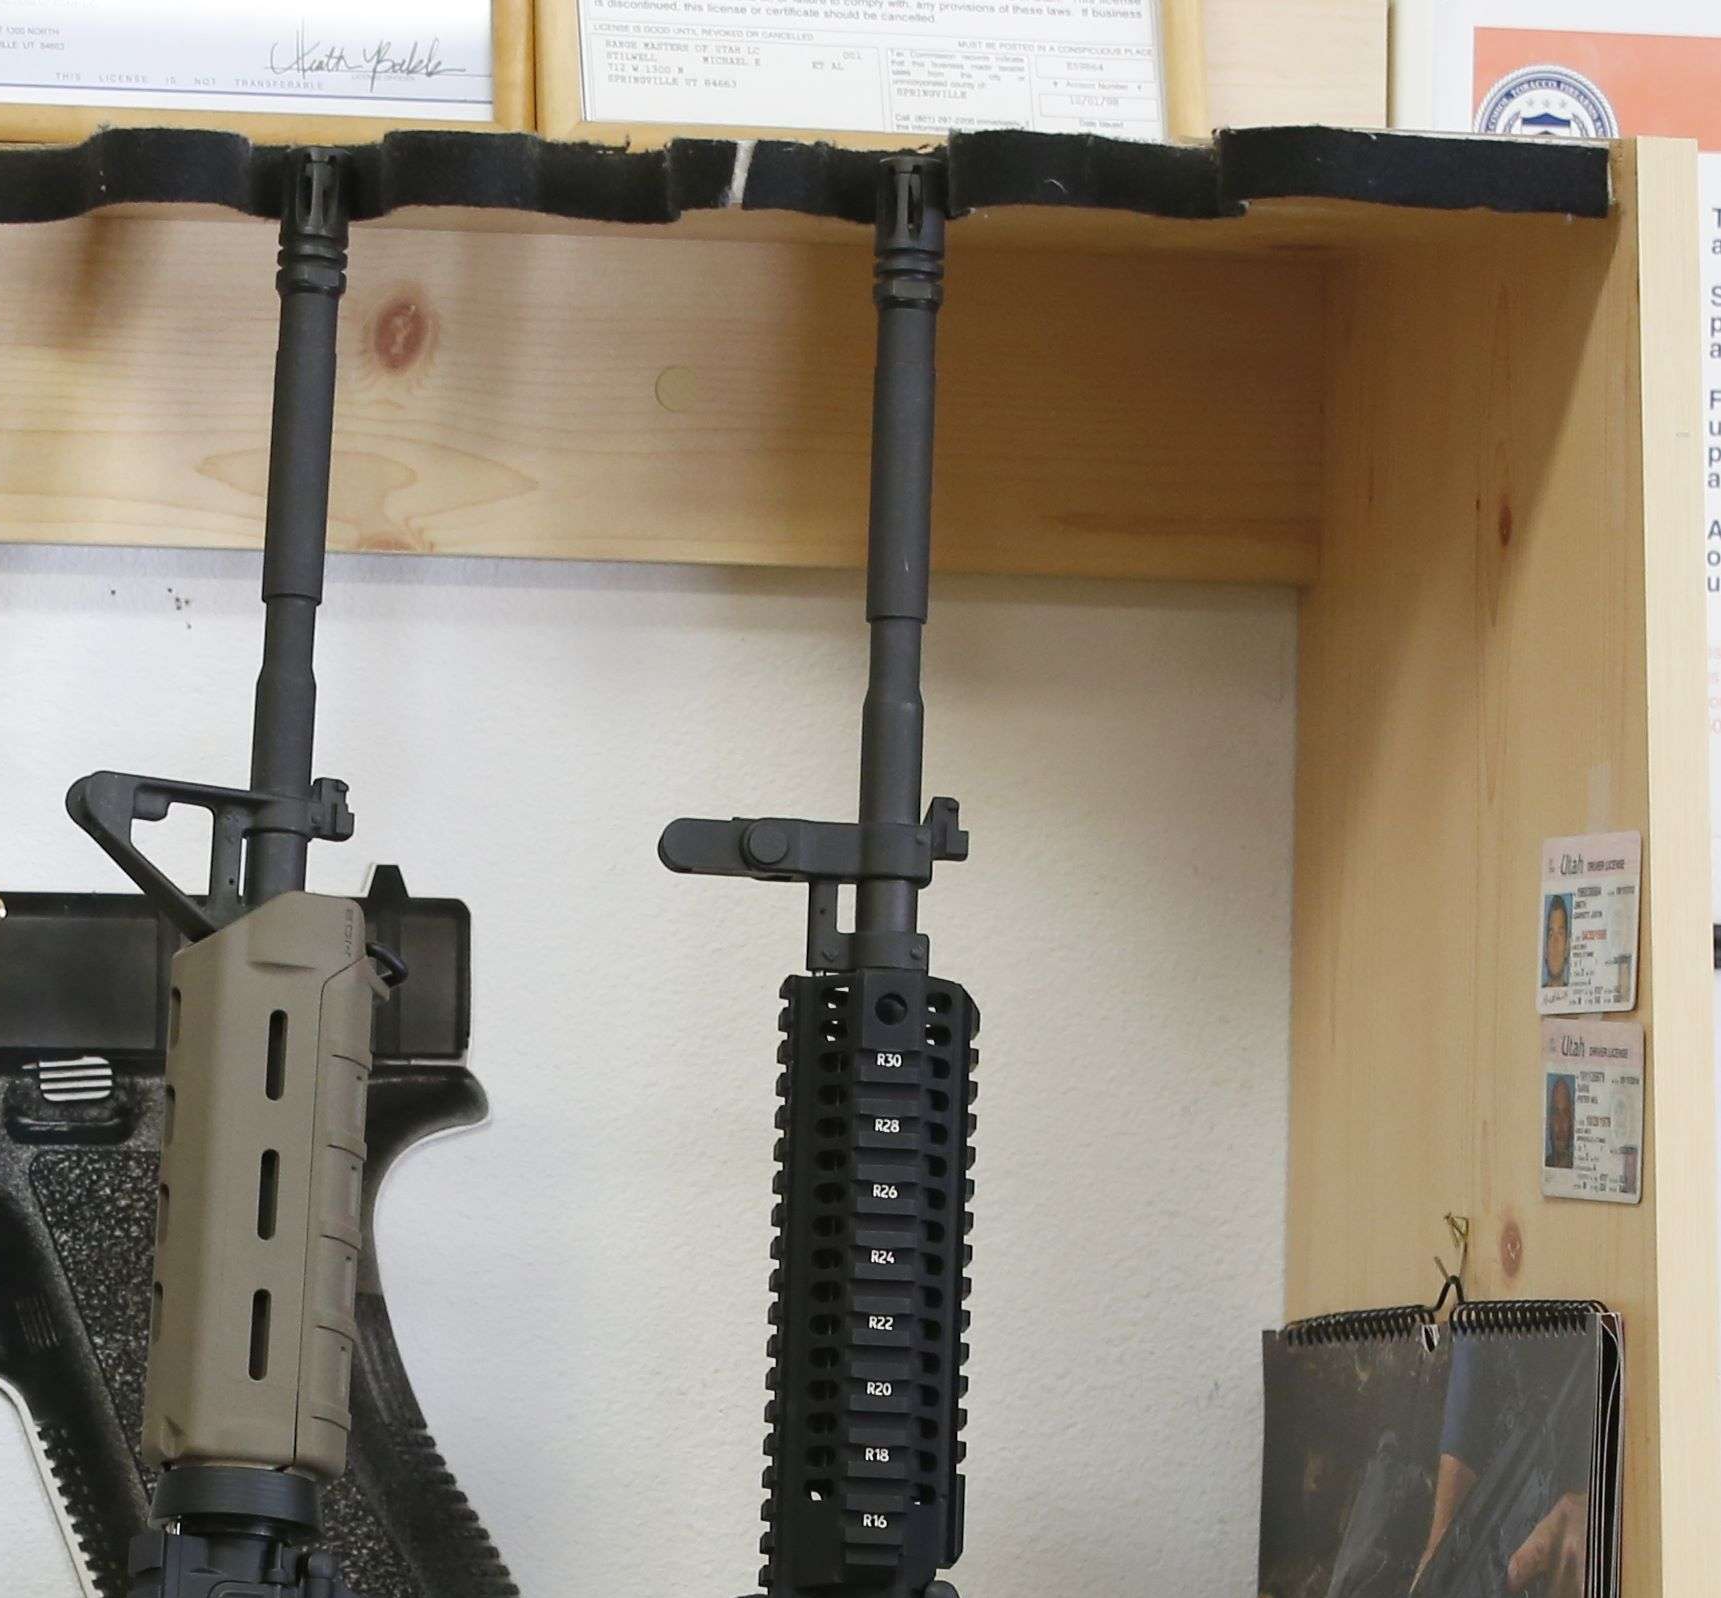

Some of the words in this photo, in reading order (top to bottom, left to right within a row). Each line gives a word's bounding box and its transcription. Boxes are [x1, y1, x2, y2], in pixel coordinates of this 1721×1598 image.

[877, 1053, 903, 1069] R30
[875, 1118, 901, 1134] R28
[872, 1183, 898, 1200] R26
[870, 1249, 895, 1265] R24
[868, 1315, 894, 1331] R22
[866, 1381, 892, 1397] R20
[865, 1446, 890, 1462] R18
[862, 1512, 887, 1529] R16
